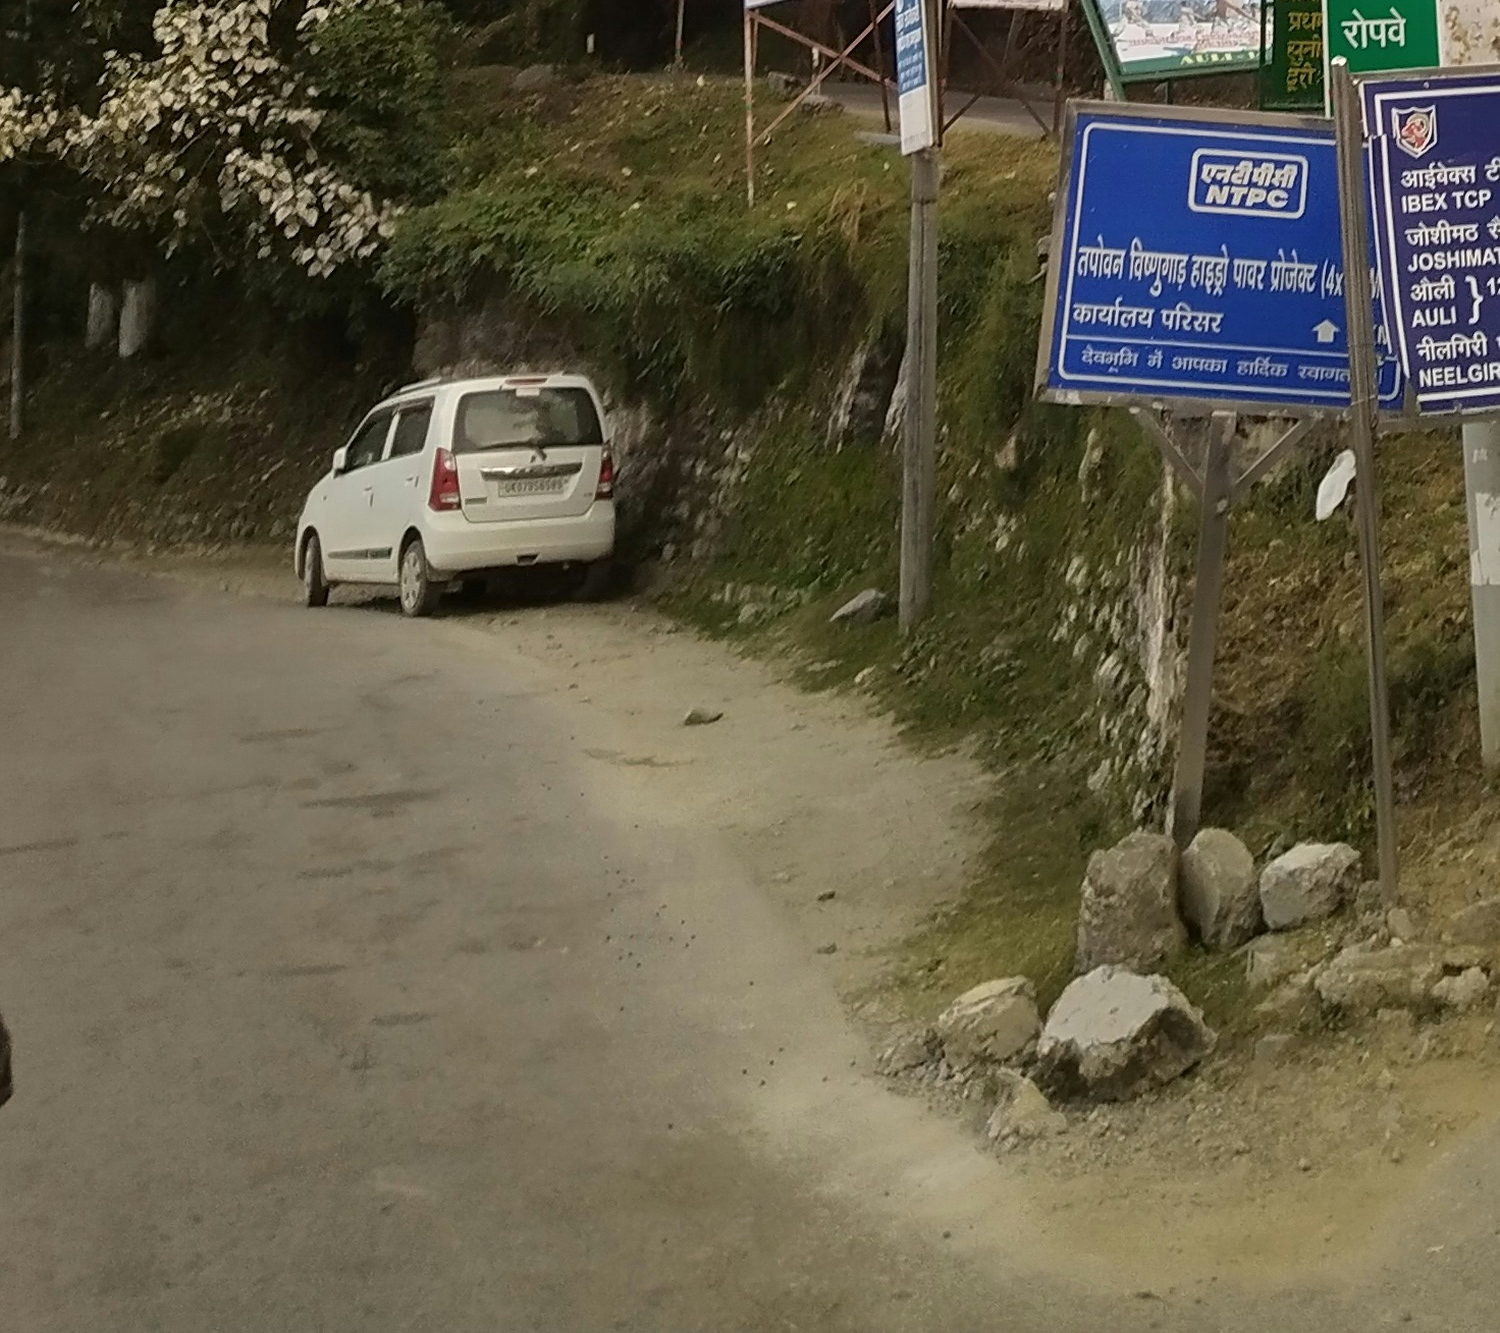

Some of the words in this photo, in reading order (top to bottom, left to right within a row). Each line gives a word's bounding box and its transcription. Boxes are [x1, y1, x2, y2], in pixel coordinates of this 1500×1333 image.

[1341, 6, 1406, 49] रोपवे
[1180, 52, 1233, 65] AULI
[1200, 160, 1297, 189] एनटीपीसी
[1206, 185, 1288, 209] NTPC
[1401, 193, 1448, 214] IBEX
[1452, 189, 1492, 210] TCP
[1405, 219, 1479, 247] जोशीमठ
[1077, 235, 1128, 280] तपोवन
[1190, 244, 1230, 296] हाइड्रो
[1233, 258, 1267, 291] पावर
[1269, 248, 1318, 293] प्रोजेक्ट
[1321, 258, 1344, 300] (4x
[1410, 274, 1455, 301] औली
[1073, 296, 1155, 329] कार्यालय
[1161, 301, 1224, 333] परिसर
[1411, 306, 1457, 328] AULI
[1416, 331, 1487, 362] नीलगिरी
[1172, 355, 1228, 373] आपका
[1236, 356, 1289, 377] हार्दिक
